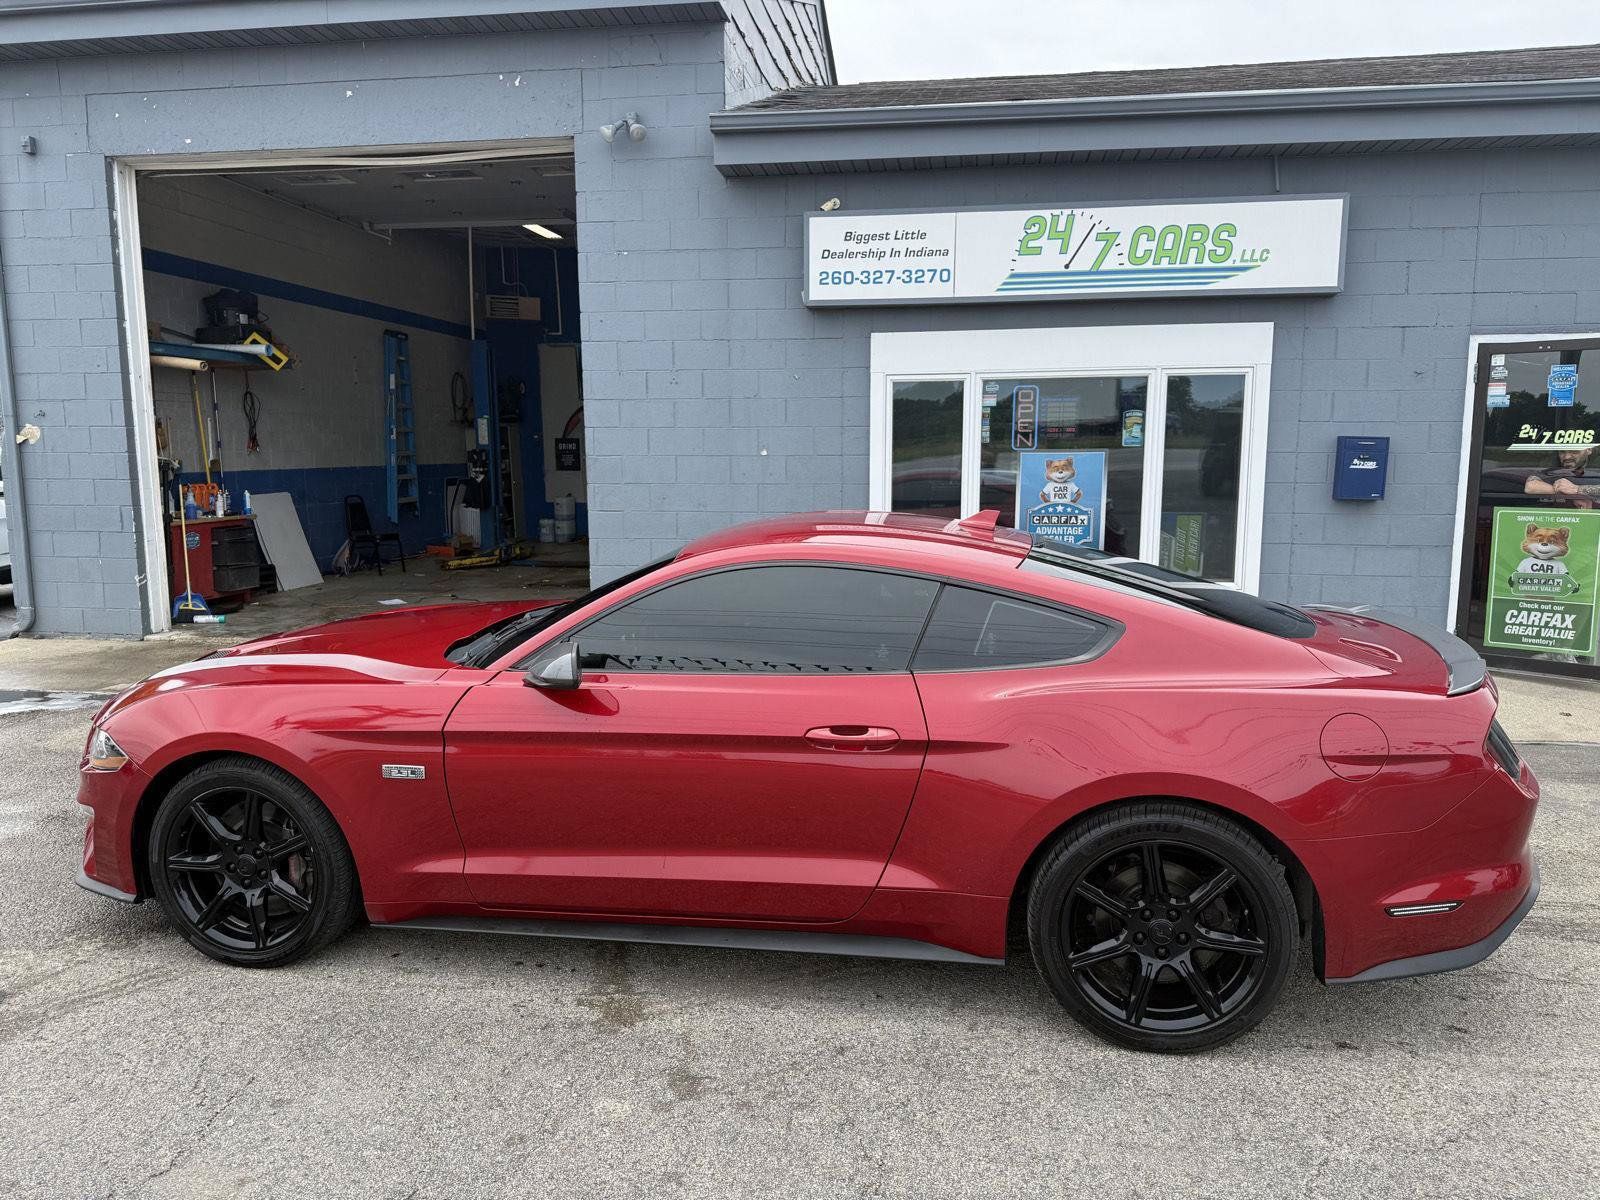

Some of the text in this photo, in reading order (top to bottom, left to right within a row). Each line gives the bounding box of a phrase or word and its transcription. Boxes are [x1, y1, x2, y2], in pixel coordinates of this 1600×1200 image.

[843, 229, 927, 244] Biggest Little
[821, 246, 949, 261] Dealership In Indiana
[1239, 248, 1271, 263] LLC
[818, 268, 951, 286] 260-327-3270
[1016, 389, 1034, 448] OPEN
[1553, 429, 1595, 444] CARS
[1053, 492, 1067, 500] FOX
[1032, 515, 1089, 526] CARFAX
[1035, 526, 1084, 536] ADVANTAGE
[1530, 562, 1554, 574] CAR
[1518, 577, 1563, 587] CARFAX
[1519, 601, 1539, 610] Check
[1540, 602, 1552, 610] out
[1505, 609, 1577, 629] CARFAX
[1504, 625, 1576, 641] GREAT VALUE
[1522, 636, 1556, 646] Inventory!
